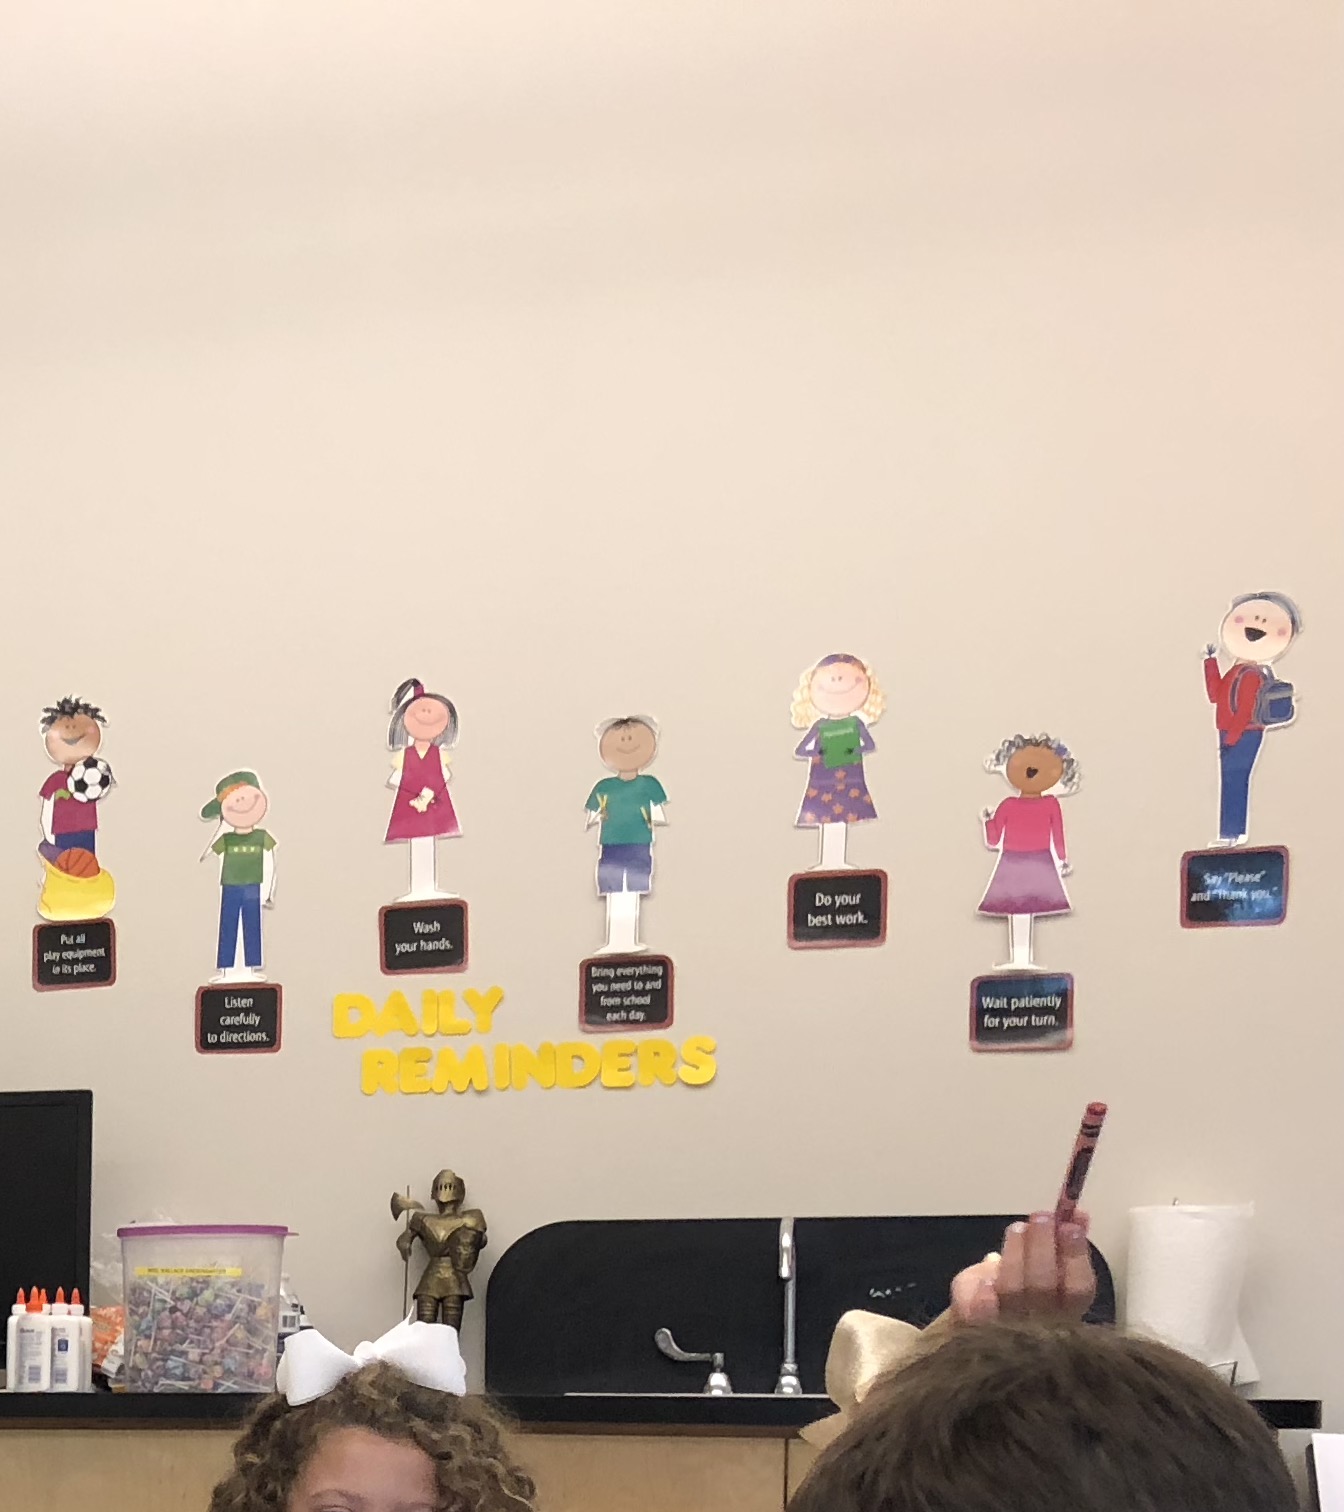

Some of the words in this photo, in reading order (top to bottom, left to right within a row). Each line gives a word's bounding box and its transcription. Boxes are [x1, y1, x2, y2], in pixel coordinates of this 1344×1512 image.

[815, 892, 832, 907] Do
[834, 893, 861, 909] your
[807, 913, 832, 927] best
[835, 910, 868, 925] work.
[413, 921, 440, 933] Wash
[76, 933, 86, 943] all
[395, 942, 417, 955] your
[420, 937, 454, 951] hands.
[43, 951, 60, 962] play
[62, 948, 105, 960] equipment
[591, 965, 615, 978] Bring
[616, 964, 663, 977] everything
[592, 983, 608, 994] you
[610, 980, 632, 991] need
[634, 980, 643, 990] to
[645, 979, 662, 990] and
[224, 996, 253, 1008] Listen
[600, 995, 621, 1006] from
[623, 994, 651, 1006] school
[982, 996, 1007, 1009] Wait
[1011, 994, 1062, 1011] patiently
[332, 985, 505, 1038] DAILY
[606, 1010, 627, 1021] each
[220, 1012, 261, 1027] carefully
[984, 1014, 999, 1027] for
[1002, 1015, 1028, 1031] your
[1031, 1014, 1059, 1027] turn.
[207, 1032, 218, 1043] to
[220, 1031, 270, 1043] directions.
[361, 1035, 717, 1096] REMINDERS
